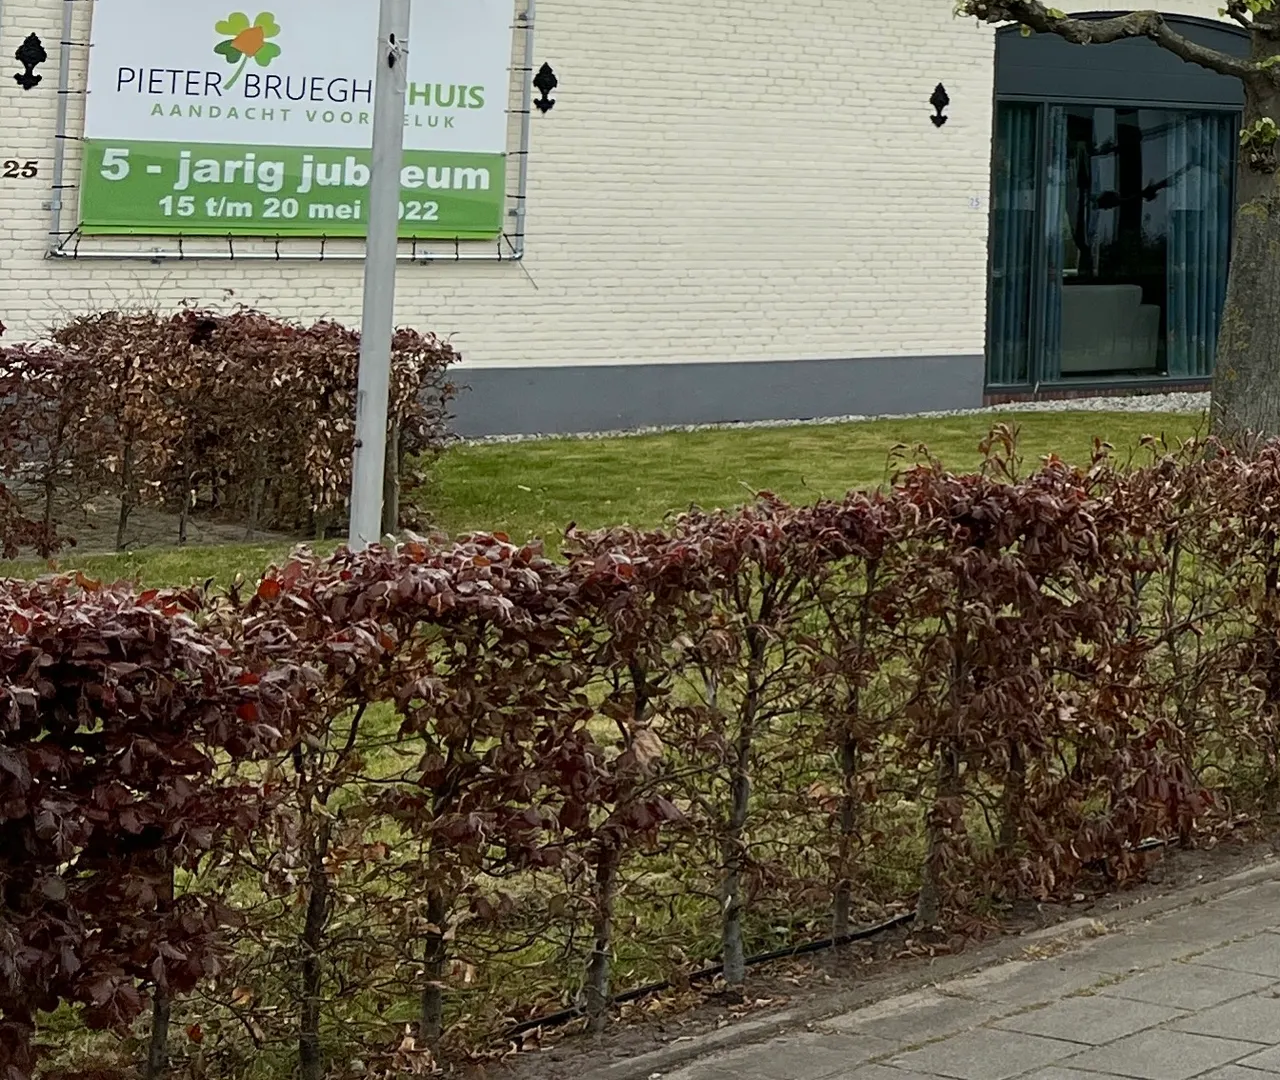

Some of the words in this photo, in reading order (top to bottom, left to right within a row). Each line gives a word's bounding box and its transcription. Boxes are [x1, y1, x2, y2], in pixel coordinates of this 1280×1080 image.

[117, 67, 223, 97] PIETER
[244, 74, 485, 109] BRUEGHHUIS
[150, 103, 291, 121] AANDACHT
[306, 110, 369, 125] VOOR
[402, 114, 455, 128] ELUK
[2, 160, 39, 178] 25
[100, 148, 130, 181] 5
[173, 150, 285, 193] jarig
[296, 155, 490, 193] jubeum
[158, 195, 195, 217] 15
[205, 196, 253, 217] t/m
[262, 198, 299, 219] 20
[308, 199, 361, 219] mei
